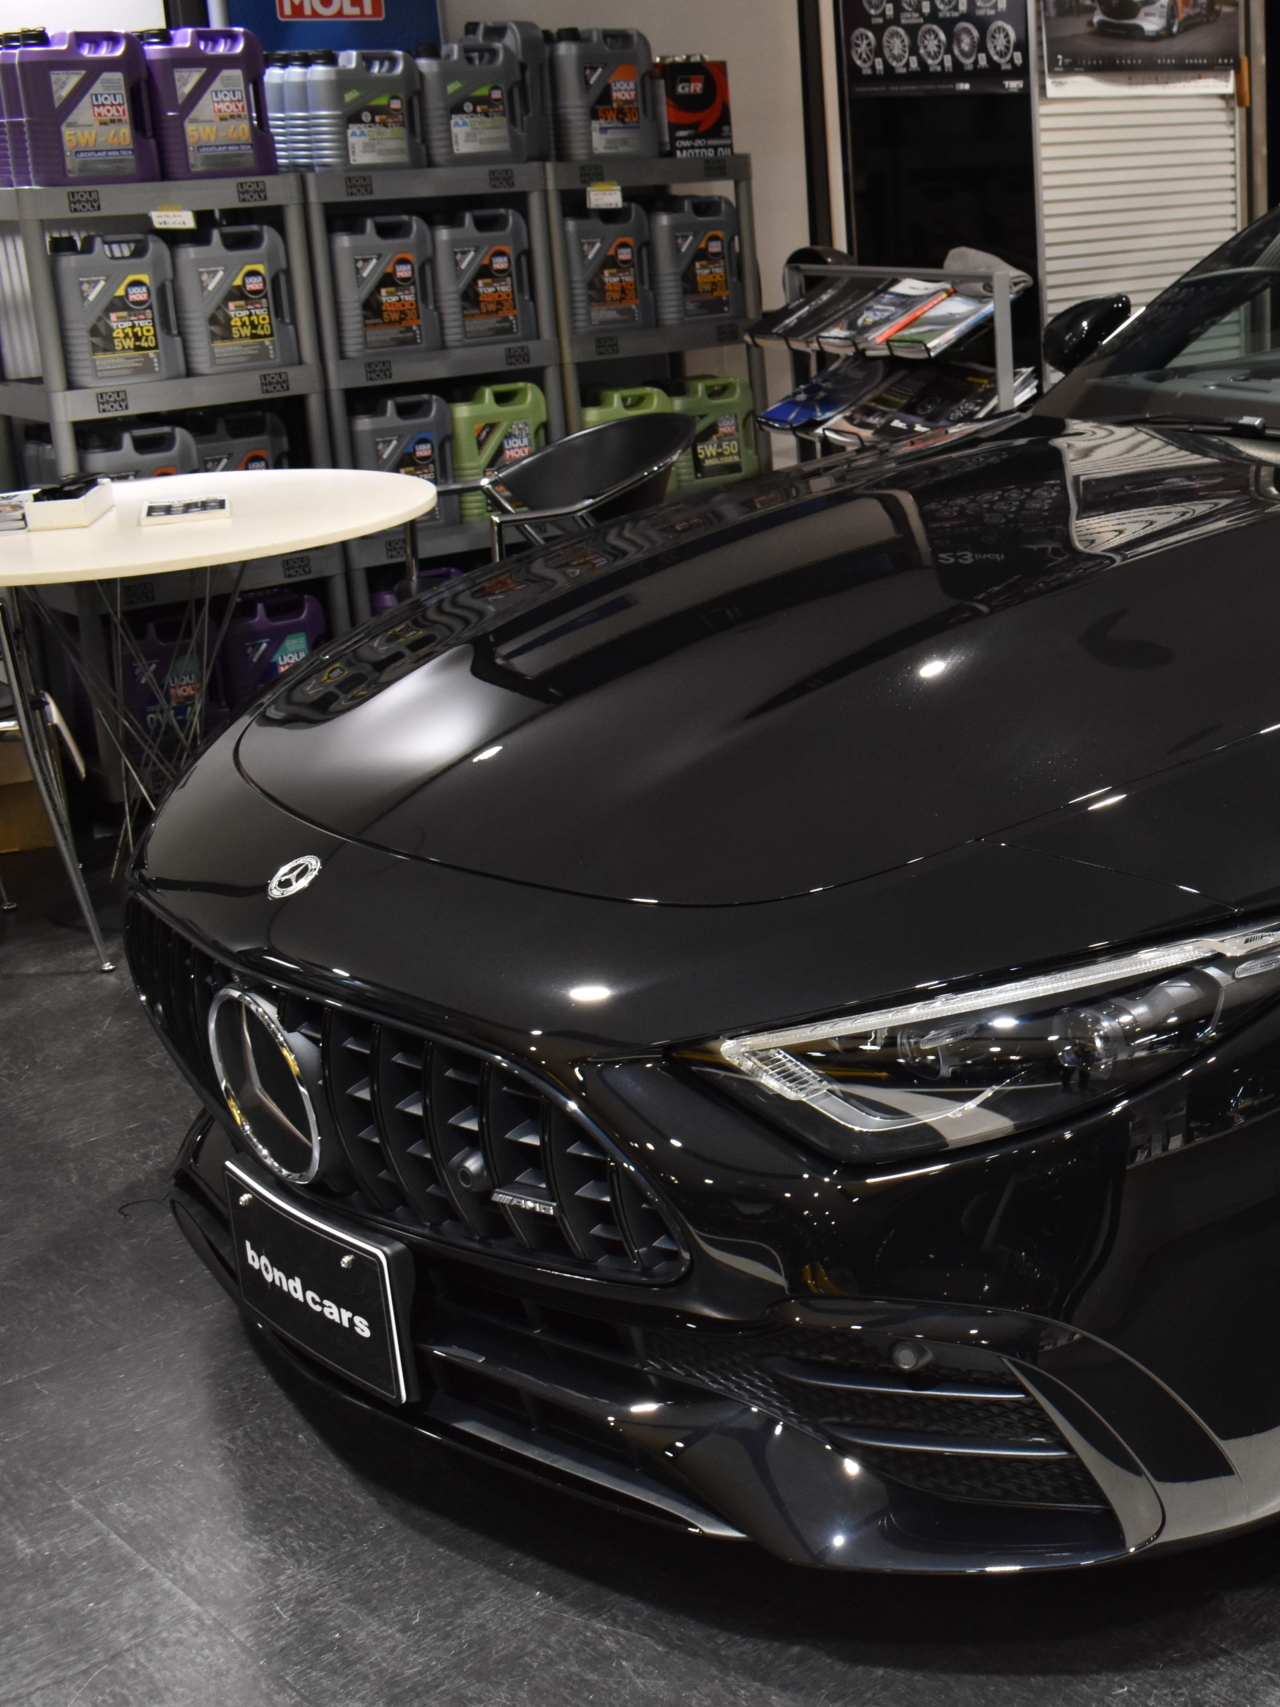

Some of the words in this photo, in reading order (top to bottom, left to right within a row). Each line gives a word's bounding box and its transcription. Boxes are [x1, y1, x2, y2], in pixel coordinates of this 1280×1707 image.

[677, 82, 702, 94] GR
[92, 94, 124, 104] LIQUI
[212, 90, 242, 102] LIQUI
[94, 105, 126, 116] MOLY
[214, 102, 246, 113] MOLY
[65, 128, 132, 148] 5W-40
[187, 124, 250, 144] 5W-40
[237, 182, 265, 192] LIQUI
[69, 192, 98, 201] LIQUI
[239, 192, 267, 202] MOLY
[70, 201, 100, 212] MOLY
[128, 286, 146, 294] LIQUI
[245, 283, 264, 291] MOLY
[129, 294, 149, 302] MOLY
[112, 320, 133, 328] TOP
[230, 314, 270, 327] 4110
[112, 326, 154, 338] 4110
[232, 323, 271, 338] 5W-40
[114, 336, 156, 350] 5W-40
[364, 362, 390, 371] LIQUI
[260, 372, 288, 384] LIQUI
[366, 370, 392, 381] MOLY
[262, 382, 290, 394] MOLY
[97, 391, 126, 402] LIQUI
[98, 402, 128, 412] MOLY
[504, 437, 528, 448] LIQUI
[506, 448, 530, 460] MOLY
[697, 440, 738, 459] 5W-50
[283, 556, 310, 568] LIQUI
[284, 566, 312, 578] MOLY
